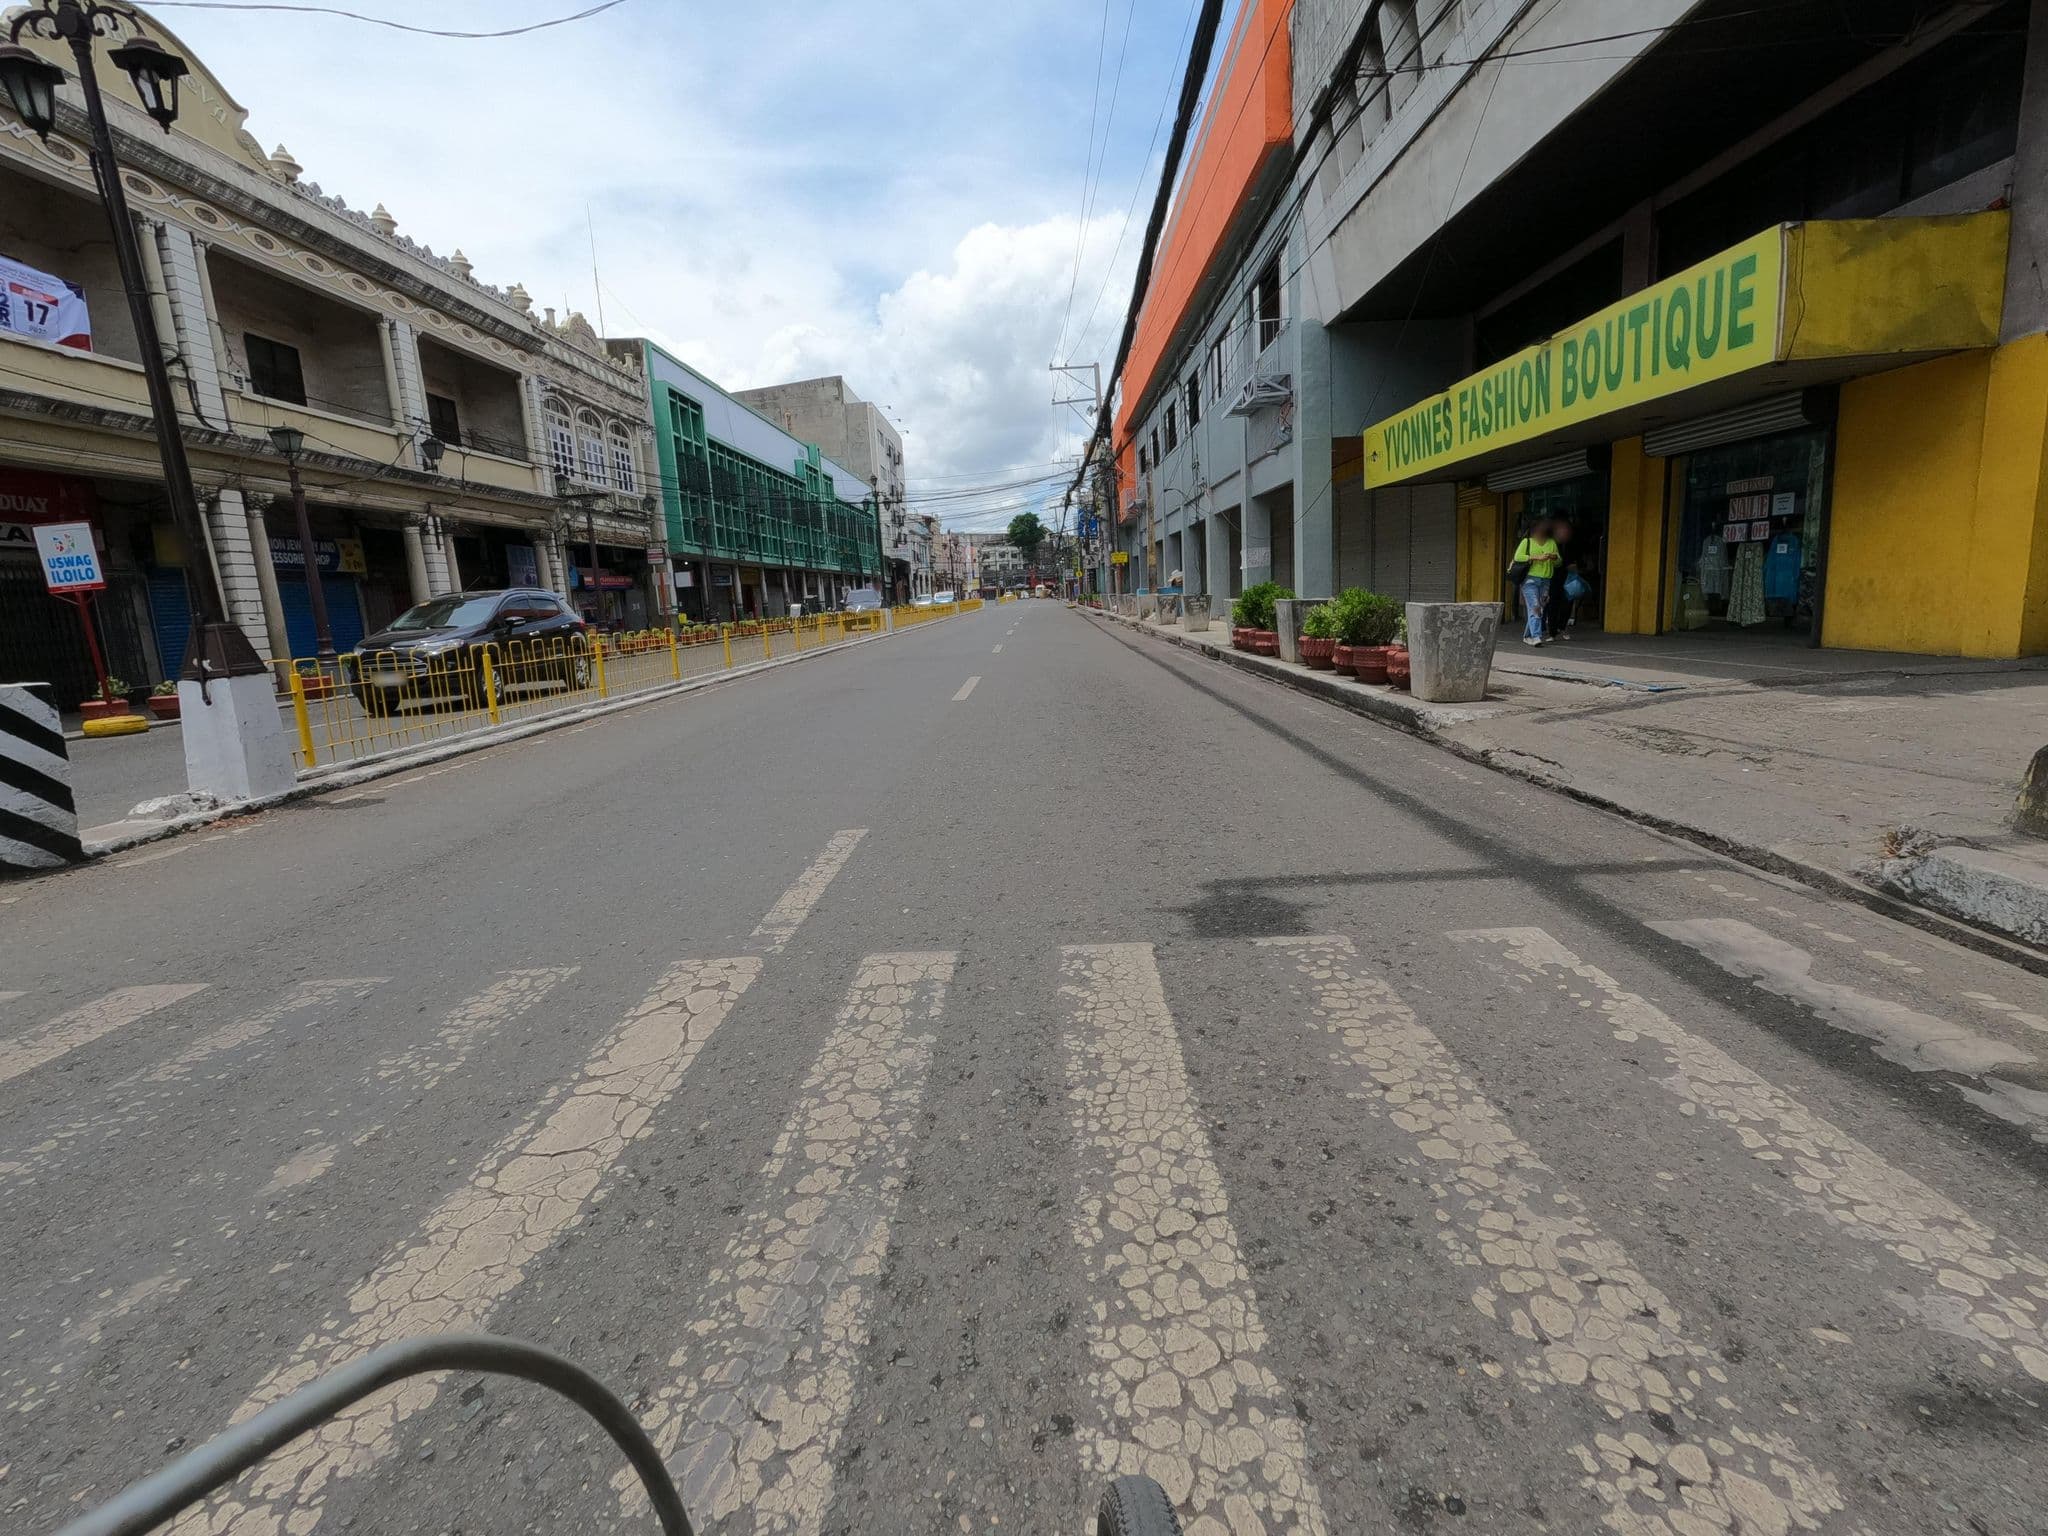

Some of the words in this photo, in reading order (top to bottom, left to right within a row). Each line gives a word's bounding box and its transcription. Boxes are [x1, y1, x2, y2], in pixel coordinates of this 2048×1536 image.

[24, 300, 49, 325] 17
[1383, 397, 1453, 471] YVONNES
[1458, 349, 1551, 446] FASHION
[1561, 253, 1758, 408] BOUTIQUE
[1730, 496, 1767, 519] SALE
[1753, 524, 1767, 537] OFF
[47, 554, 92, 569] USWAG
[51, 567, 96, 583] ILOILO
